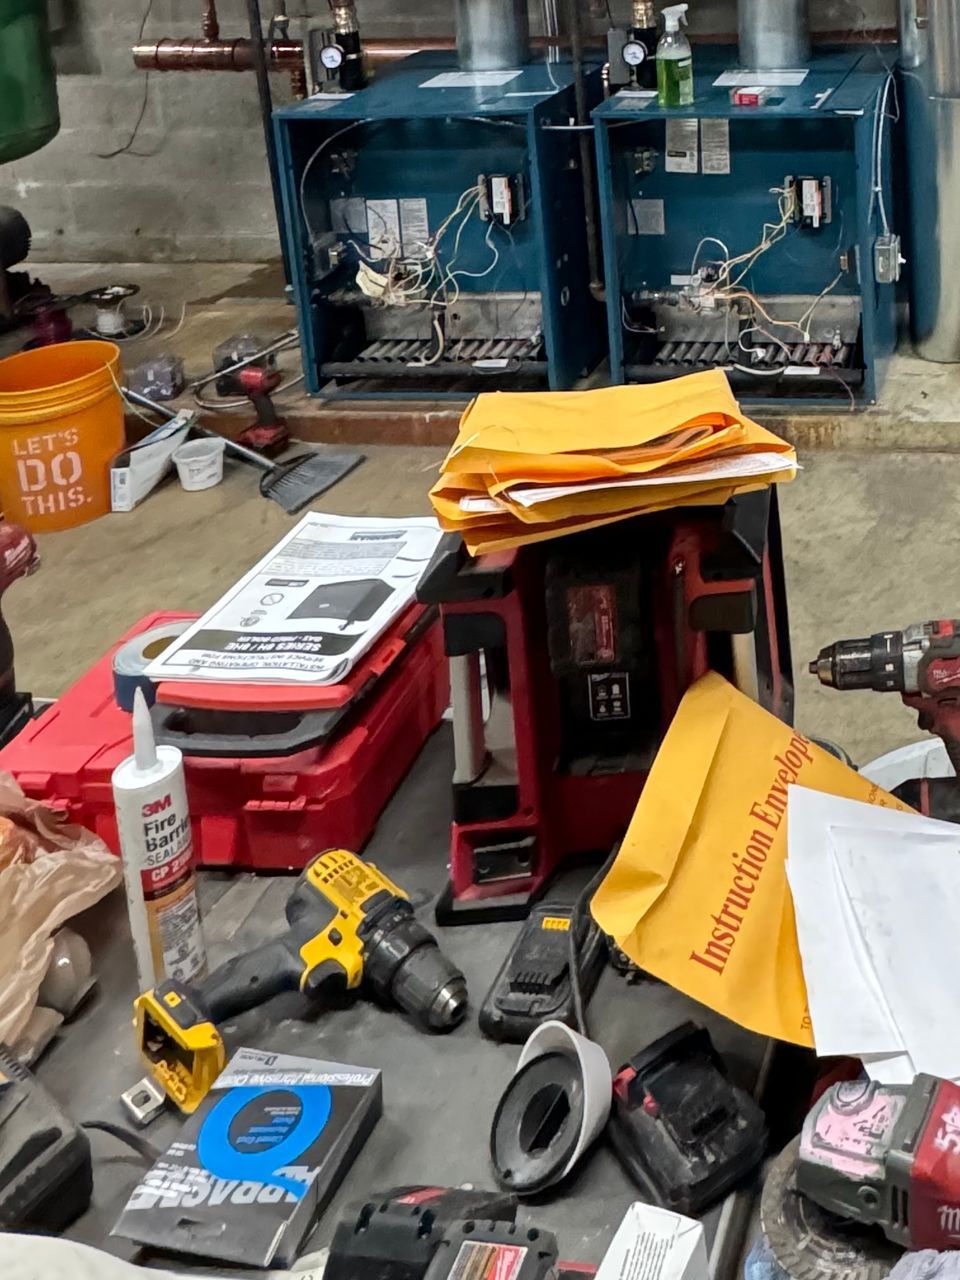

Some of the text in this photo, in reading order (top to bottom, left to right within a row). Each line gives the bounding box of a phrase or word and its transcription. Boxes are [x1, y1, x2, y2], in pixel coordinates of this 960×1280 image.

[13, 428, 79, 456] LET'S
[17, 450, 83, 493] DO
[20, 486, 93, 516] THIS.
[275, 642, 322, 652] SERIES
[141, 793, 172, 819] 3M
[143, 812, 177, 838] Fire
[145, 816, 190, 853] Barri
[688, 831, 775, 977] Instruction
[303, 1072, 374, 1086] Professional
